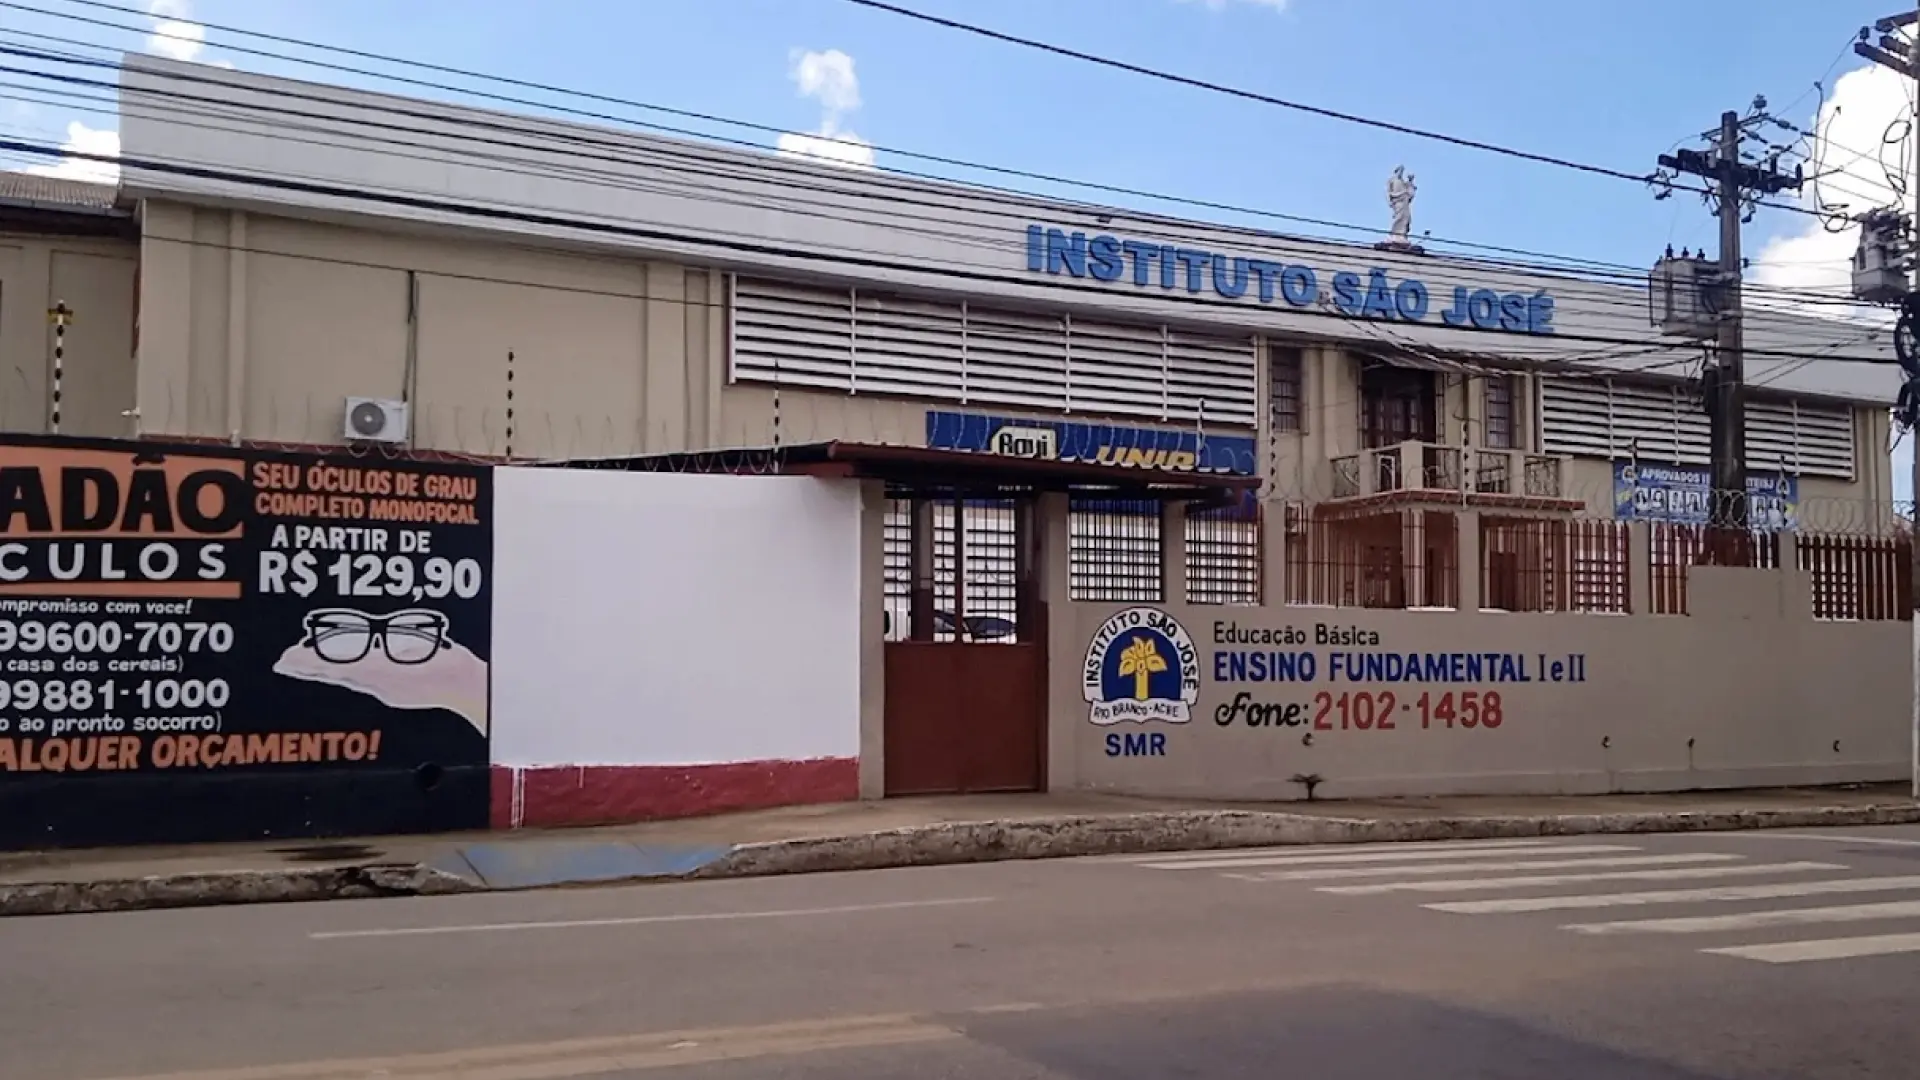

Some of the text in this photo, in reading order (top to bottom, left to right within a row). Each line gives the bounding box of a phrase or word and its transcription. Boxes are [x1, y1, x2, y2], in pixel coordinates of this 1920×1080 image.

[1026, 224, 1554, 333] INSTITUTO SÃO JOSÉ
[253, 459, 477, 500] SEU ÓCULOS DE GRAU
[255, 492, 479, 525] COMPLETO MONOFOCAL
[271, 524, 431, 553] A PARTIR DE
[259, 550, 482, 603] R$ 129,90
[0, 598, 193, 617] mpromisso com voce!
[1086, 611, 1140, 687] INSTITUTO
[1214, 621, 1380, 646] Educação Básica
[7, 659, 55, 672] casa
[62, 656, 99, 672] dos
[108, 656, 184, 672] cereais)
[1214, 651, 1316, 682] ENSINO
[1329, 653, 1531, 682] FUNDAMENTAL
[18, 716, 44, 731] ao
[52, 712, 125, 736] pronto
[133, 711, 222, 732] socorro)
[151, 730, 381, 769] ORÇAMENTO!
[1105, 733, 1166, 757] SMR
